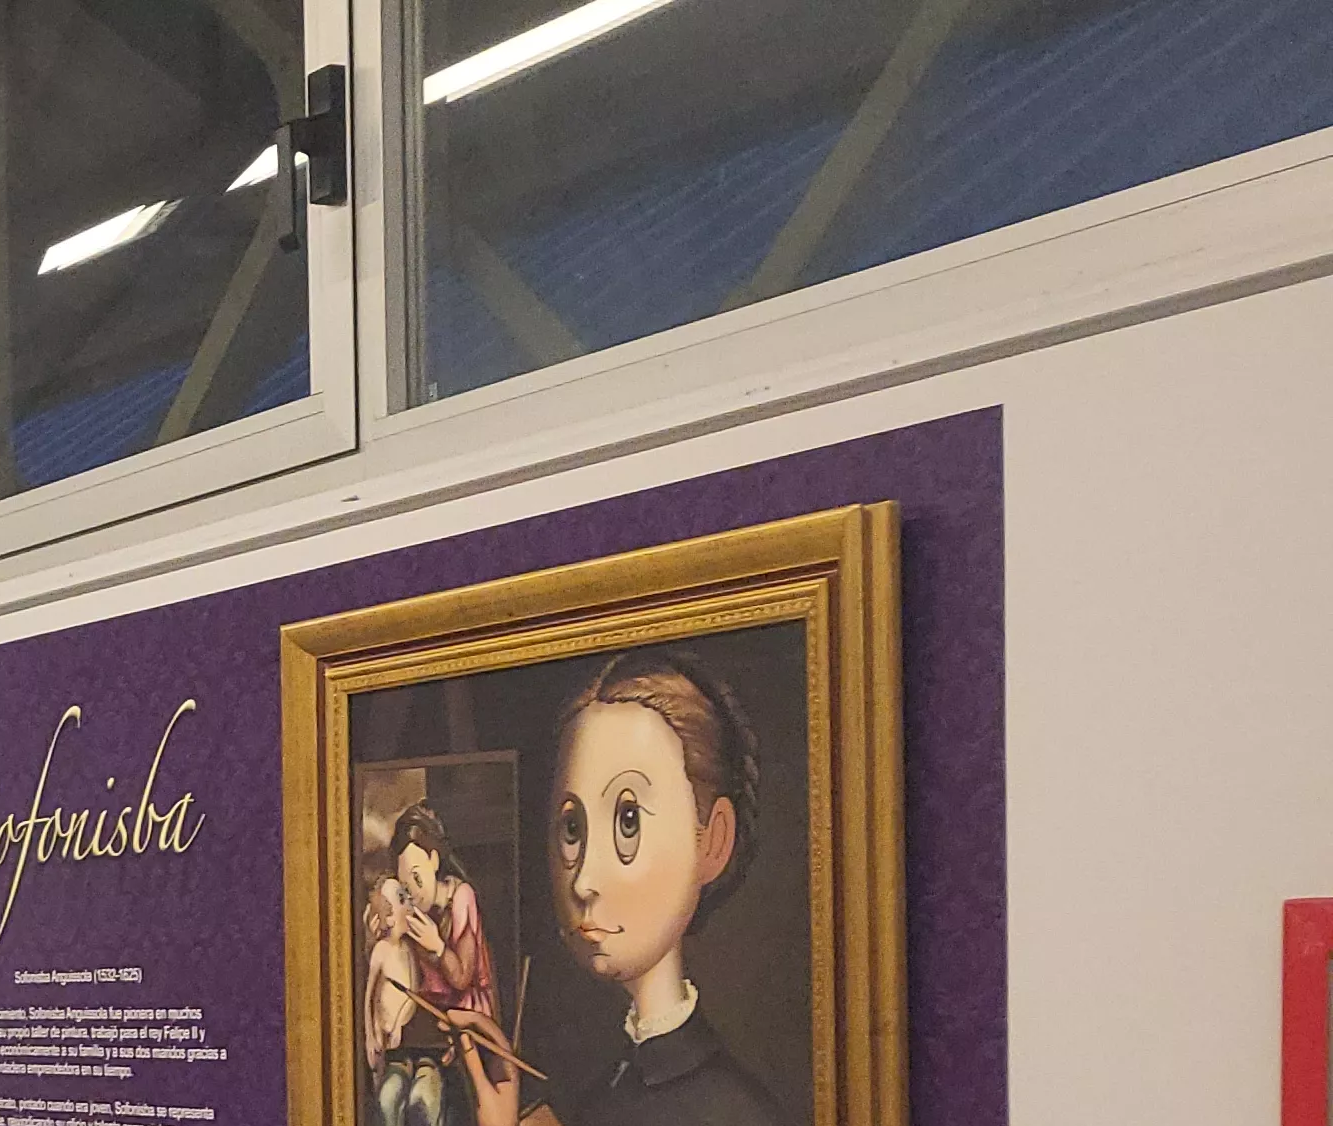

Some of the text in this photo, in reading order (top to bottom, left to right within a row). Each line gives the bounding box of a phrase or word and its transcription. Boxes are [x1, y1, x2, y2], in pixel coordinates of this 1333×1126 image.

[167, 1006, 202, 1020] muchos
[163, 1025, 190, 1042] Felipe
[151, 1045, 185, 1059] maridos
[187, 1045, 218, 1062] gracias
